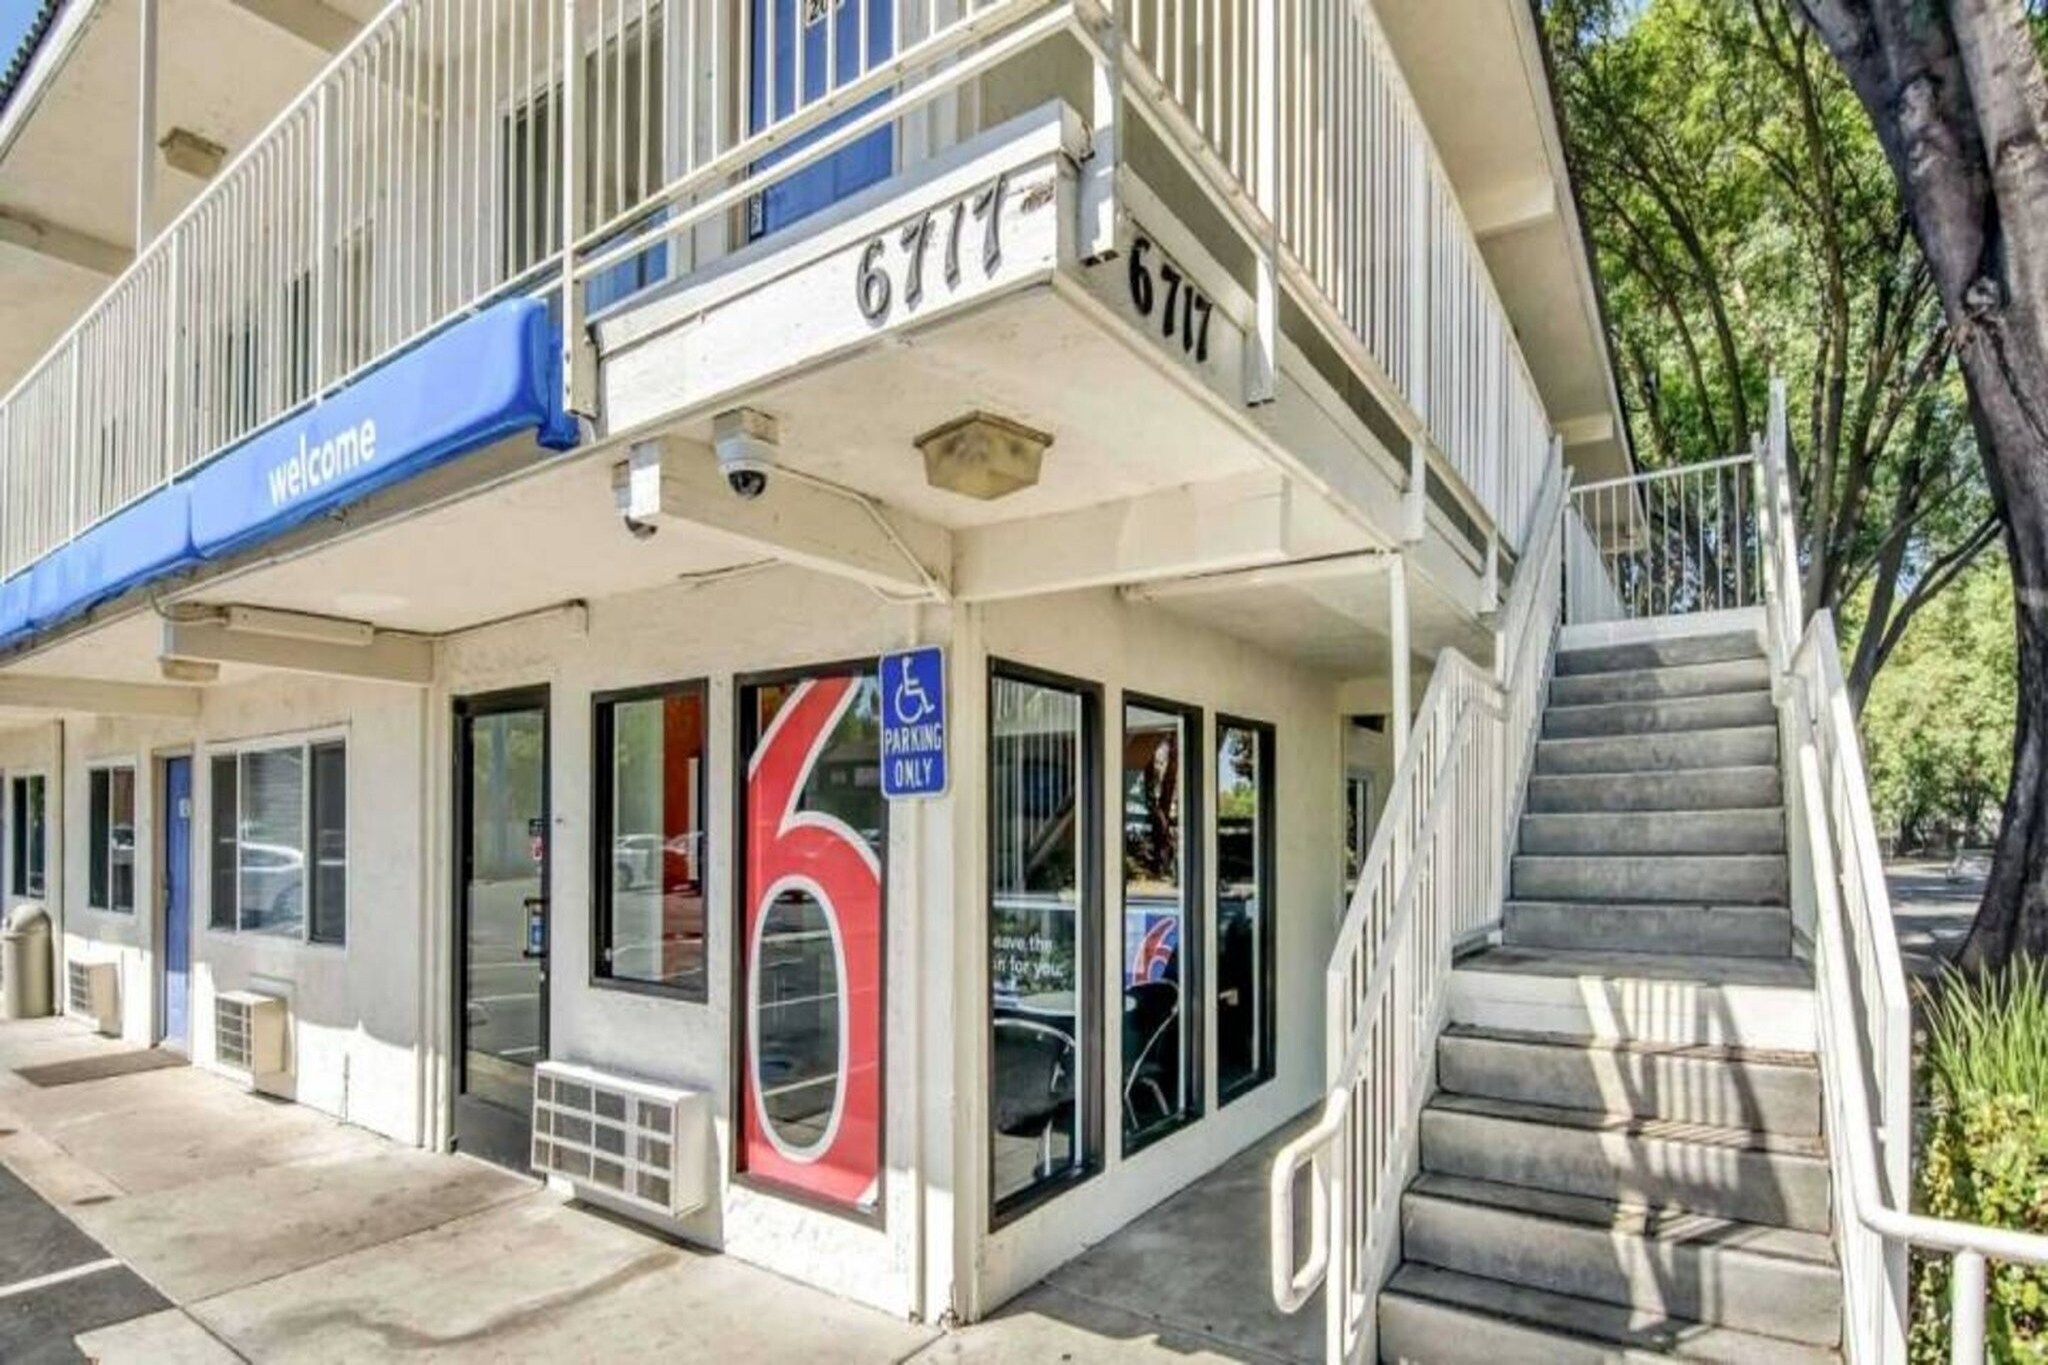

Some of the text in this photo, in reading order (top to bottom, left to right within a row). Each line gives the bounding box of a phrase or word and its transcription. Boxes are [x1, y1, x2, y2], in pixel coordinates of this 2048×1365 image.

[857, 173, 1007, 326] 6717
[1129, 237, 1213, 363] 6717
[268, 419, 375, 507] welcome
[885, 724, 941, 755] PARKING
[895, 758, 932, 788] ONLY
[747, 674, 881, 1206] 6
[1029, 933, 1053, 954] the
